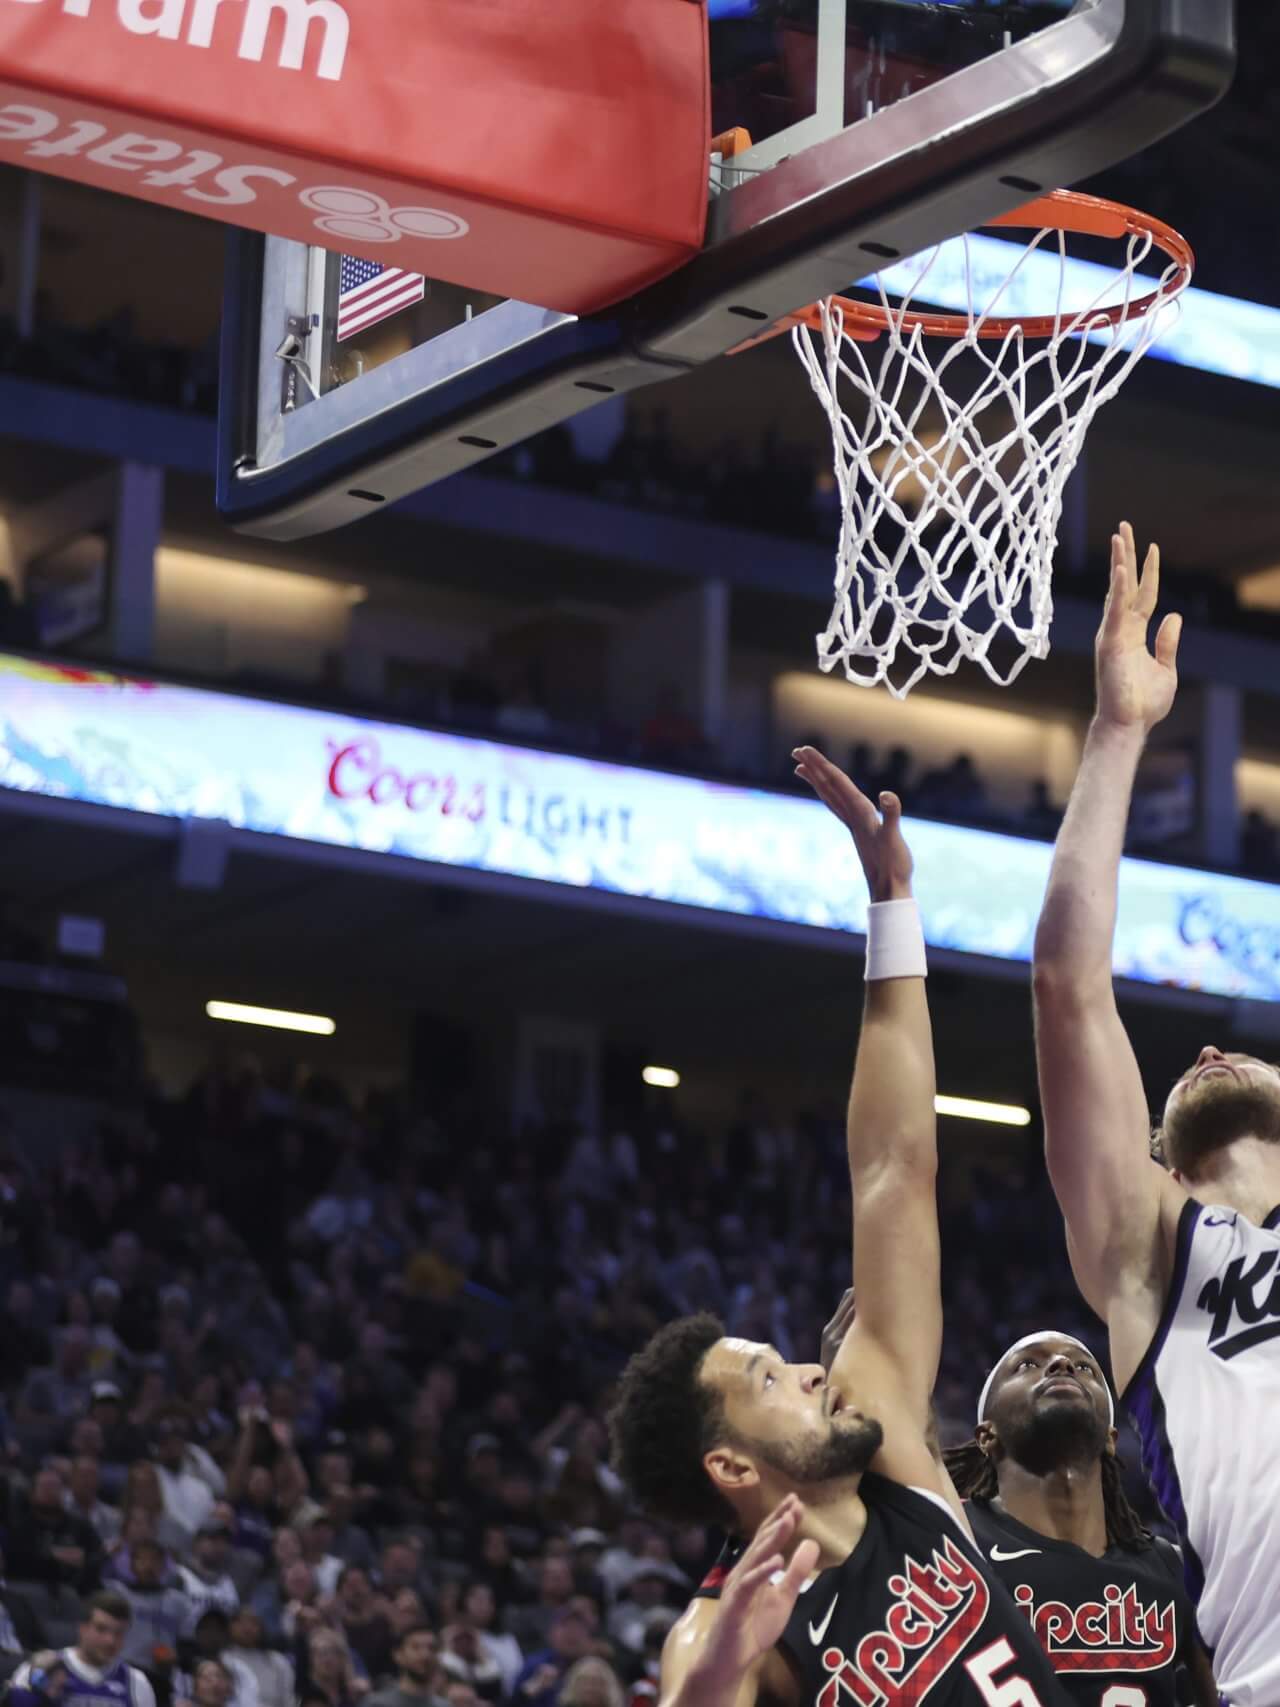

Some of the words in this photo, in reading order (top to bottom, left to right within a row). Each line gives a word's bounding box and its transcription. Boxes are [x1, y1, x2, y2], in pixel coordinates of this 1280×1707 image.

[62, 0, 350, 81] arm
[0, 104, 297, 206] State
[324, 735, 487, 822] Coors
[499, 783, 634, 845] LIGHT
[1013, 1582, 1177, 1674] ipcity
